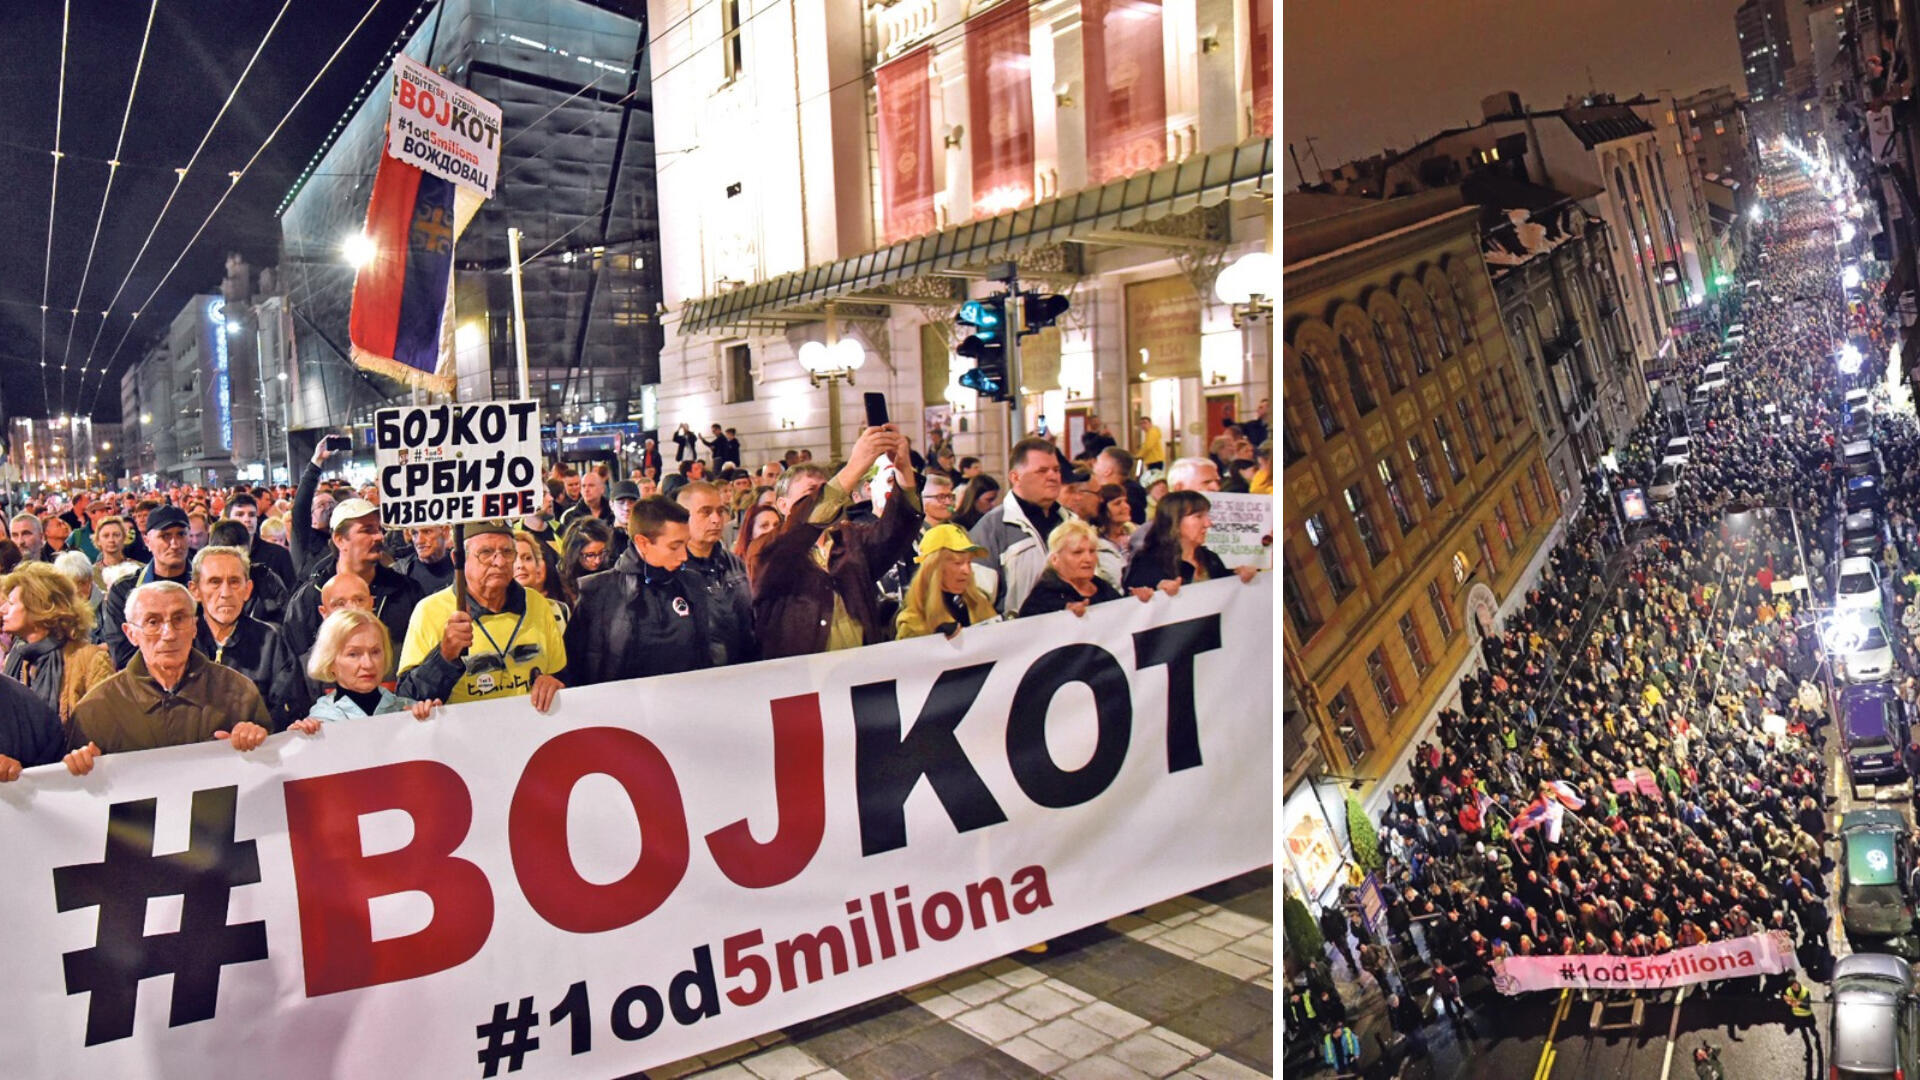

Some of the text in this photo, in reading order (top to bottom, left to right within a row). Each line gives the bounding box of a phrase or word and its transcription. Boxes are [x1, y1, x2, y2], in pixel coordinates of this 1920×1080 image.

[398, 79, 499, 149] BOJKOT
[398, 116, 479, 166] #1od5miliona
[402, 136, 489, 191] ВОЖДОВАЦ
[377, 402, 537, 450] БОЈКОТ
[382, 450, 534, 497] СРБИЈО
[382, 490, 535, 524] ИЗБОРЕ БРЕ
[52, 612, 1222, 1047] #BOJKOT
[476, 864, 1054, 1079] #1od5miliona
[1559, 949, 1755, 982] #1od5miliona
